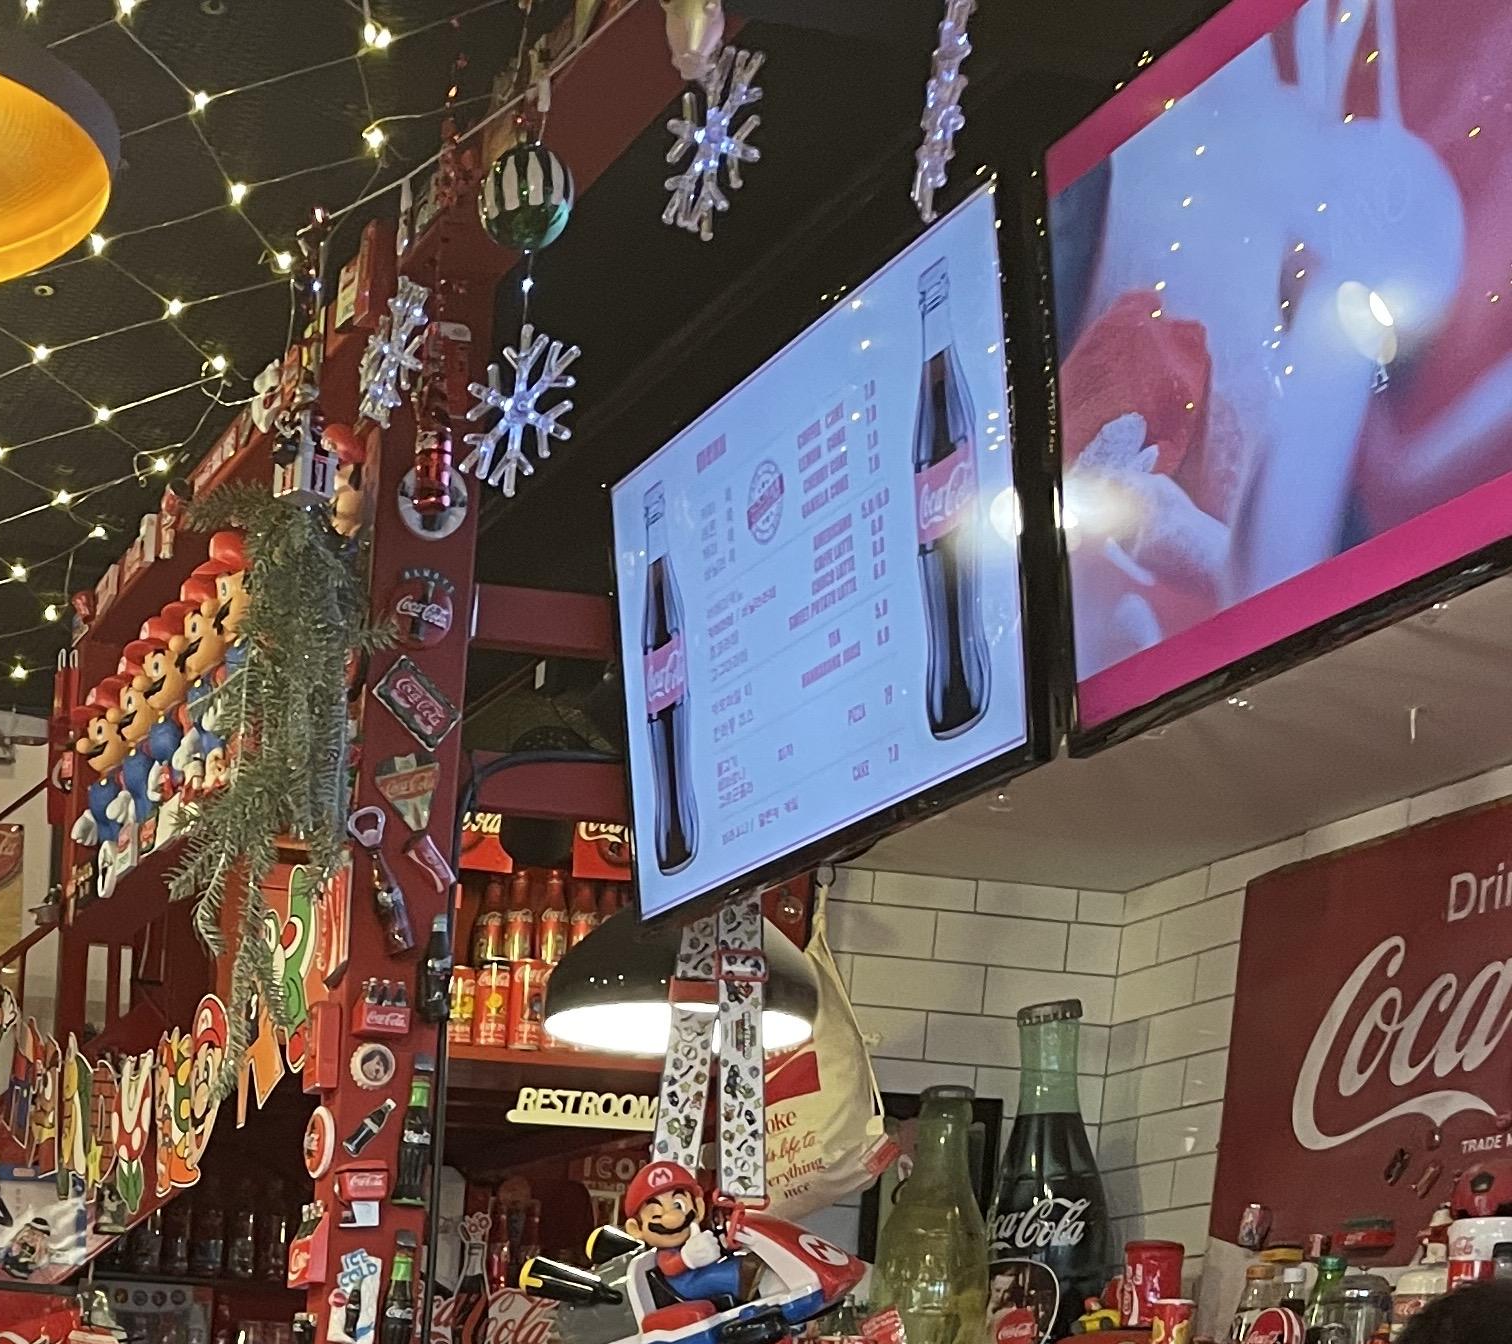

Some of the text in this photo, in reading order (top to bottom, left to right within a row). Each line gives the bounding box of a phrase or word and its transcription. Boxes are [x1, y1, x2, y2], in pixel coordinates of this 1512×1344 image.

[396, 596, 449, 630] Coca-Cola
[765, 1110, 797, 1135] oke
[1462, 1136, 1504, 1155] TRADE
[767, 1156, 828, 1188] erything
[343, 1251, 368, 1271] ICE
[339, 1262, 378, 1290] COLD
